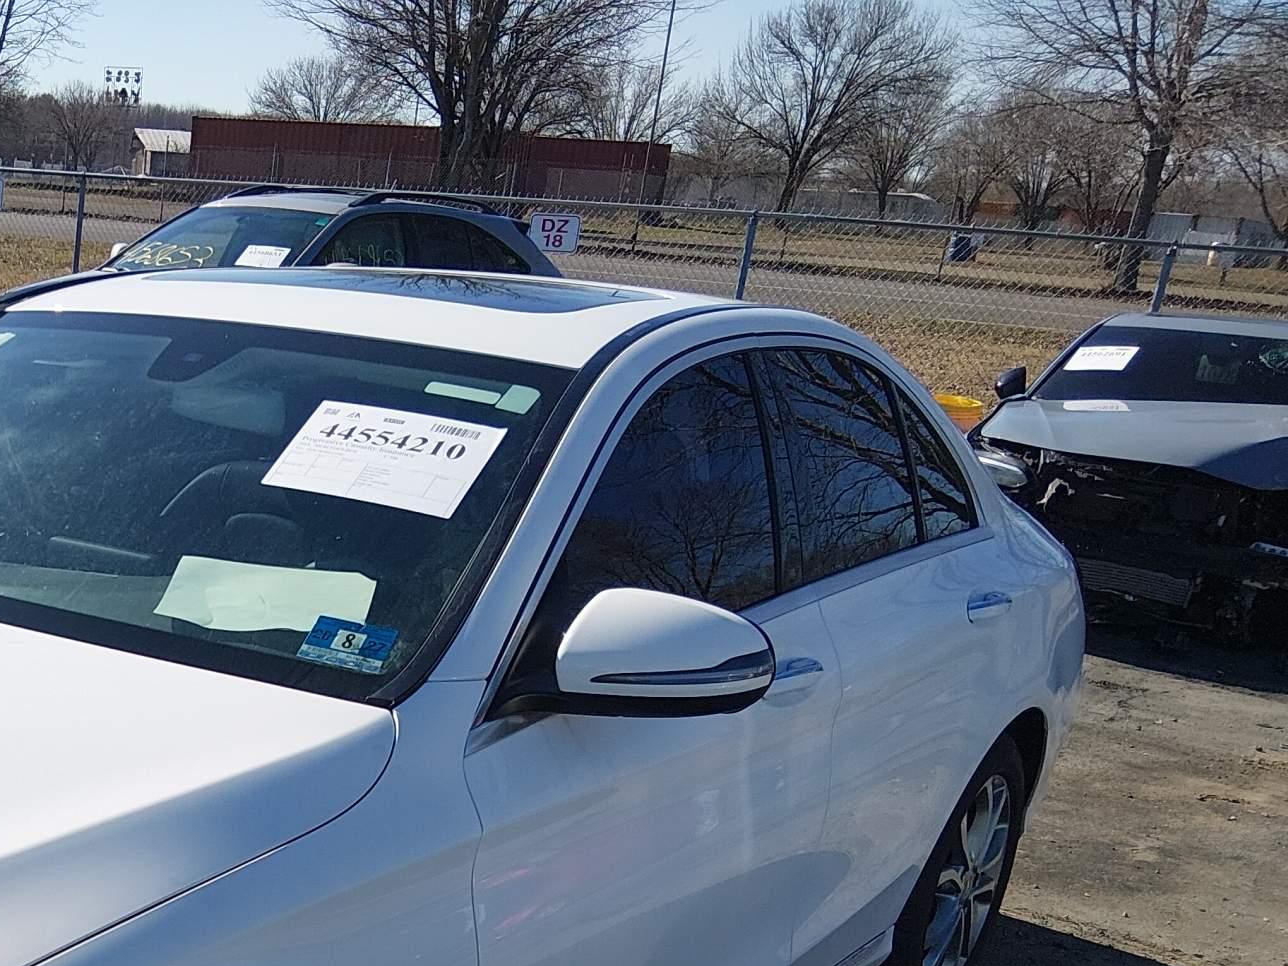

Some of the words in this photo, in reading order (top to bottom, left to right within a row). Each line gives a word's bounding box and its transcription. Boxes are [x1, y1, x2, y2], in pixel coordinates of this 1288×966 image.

[541, 218, 569, 233] DZ
[543, 234, 563, 248] 18
[319, 423, 467, 461] 44554210
[342, 633, 355, 649] 8
